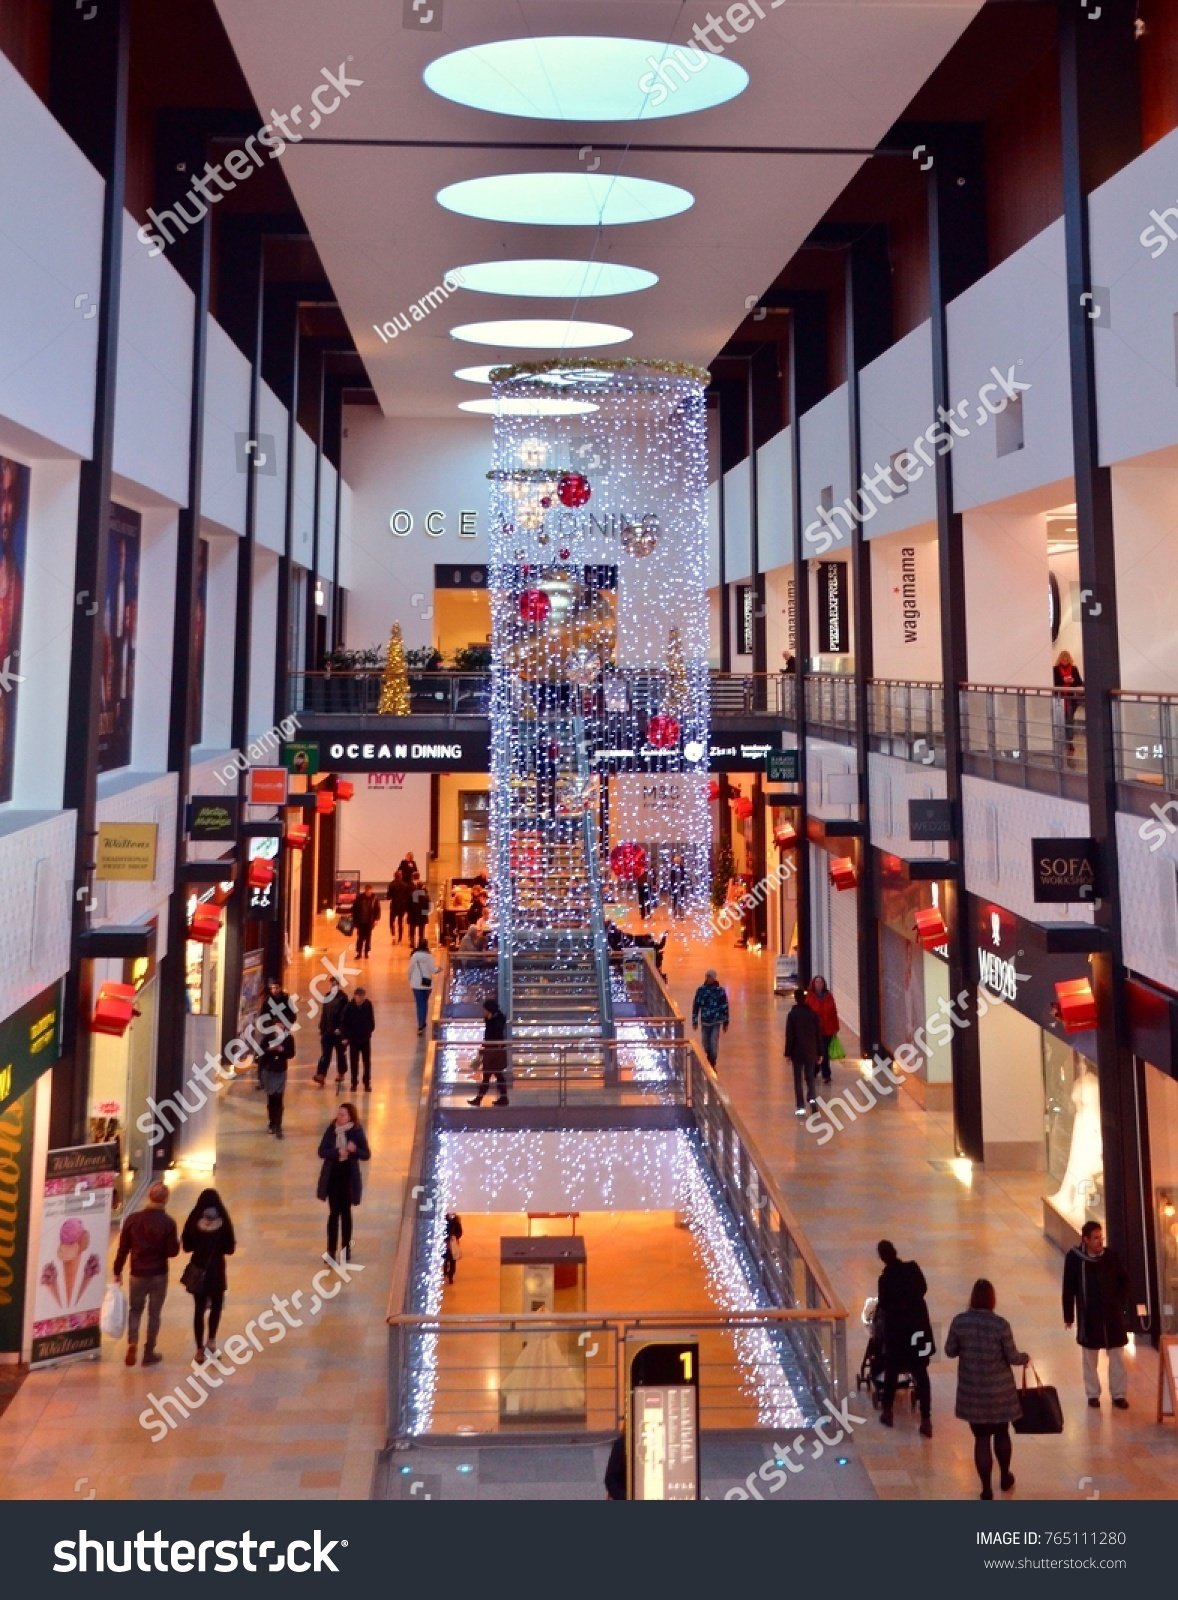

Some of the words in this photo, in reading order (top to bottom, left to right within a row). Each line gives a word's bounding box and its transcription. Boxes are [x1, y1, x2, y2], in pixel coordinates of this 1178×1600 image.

[902, 547, 920, 644] wagamama
[330, 744, 407, 759] OCEAN
[411, 744, 462, 759] DINING
[1040, 857, 1095, 877] SOFA
[978, 946, 1018, 1001] WED2B
[679, 1351, 693, 1380] 1
